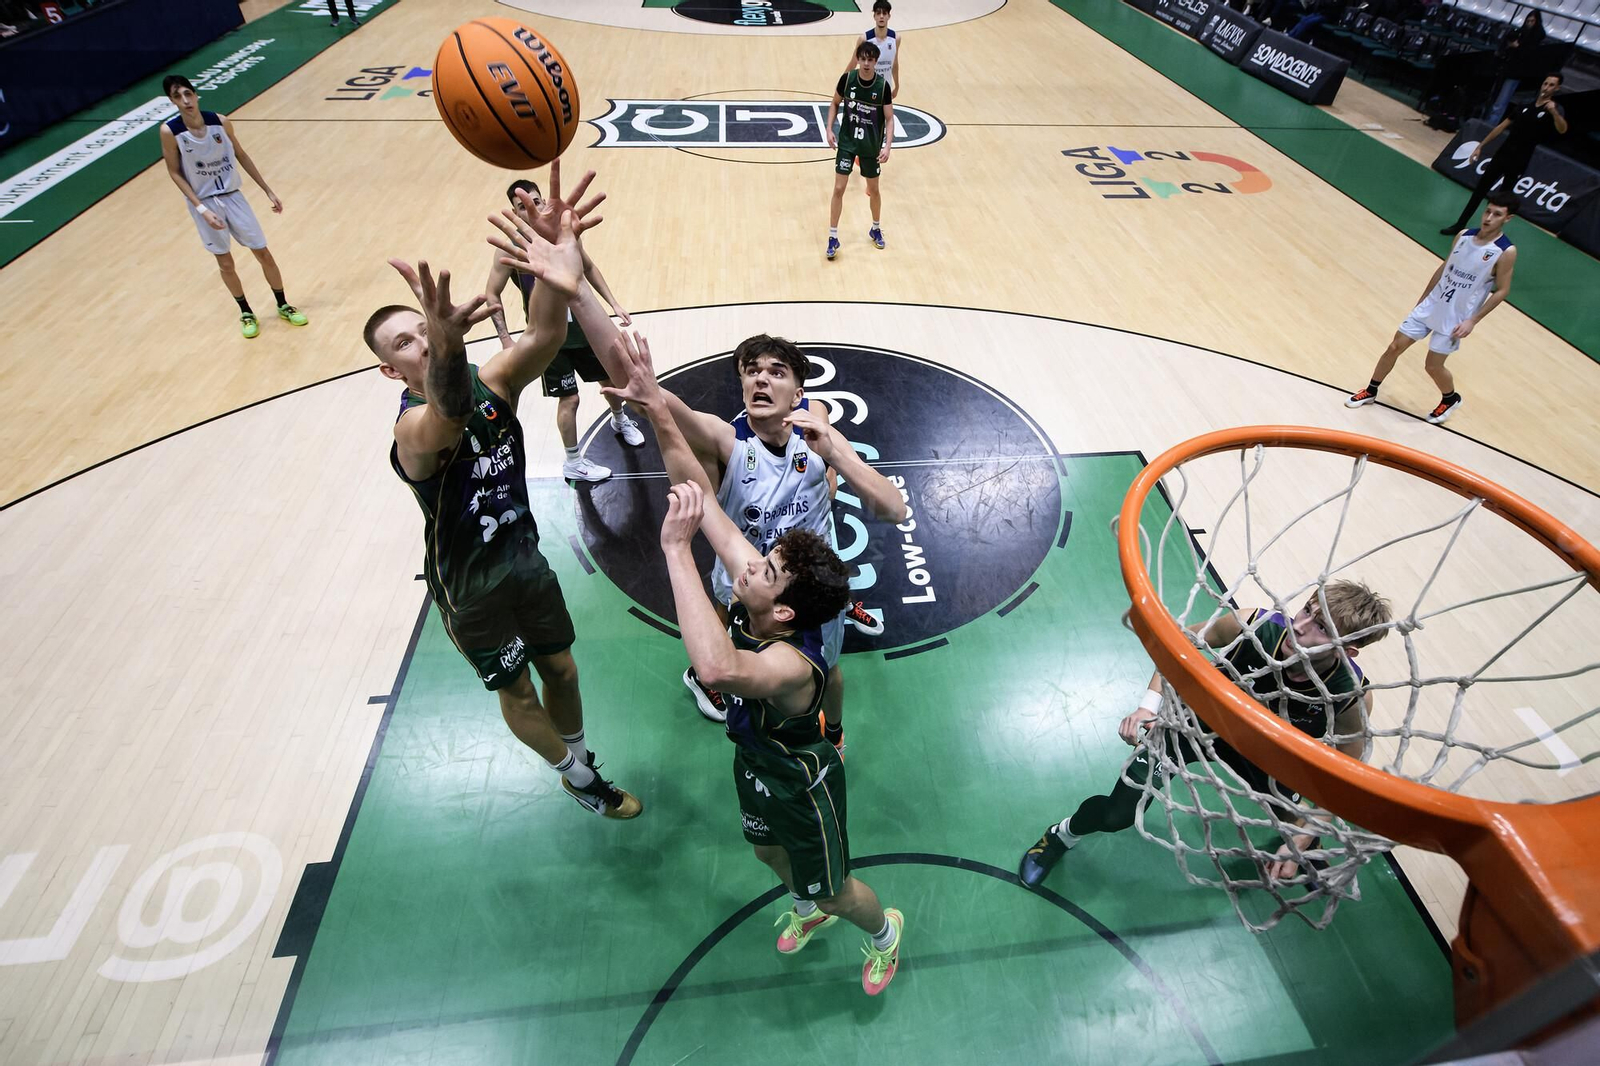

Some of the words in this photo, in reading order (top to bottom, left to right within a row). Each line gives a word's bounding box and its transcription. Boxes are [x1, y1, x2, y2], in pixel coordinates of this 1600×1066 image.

[733, 0, 773, 26] flexyg
[324, 65, 406, 101] LIGA
[513, 26, 573, 129] Wilson
[1253, 43, 1322, 84] SOMDOCENTS
[487, 62, 538, 119] EVO
[854, 127, 865, 140] 13
[0, 150, 92, 207] juntament
[1061, 146, 1151, 199] LIGA
[764, 500, 809, 524] PROBITAS
[888, 475, 937, 605] Low-ce
